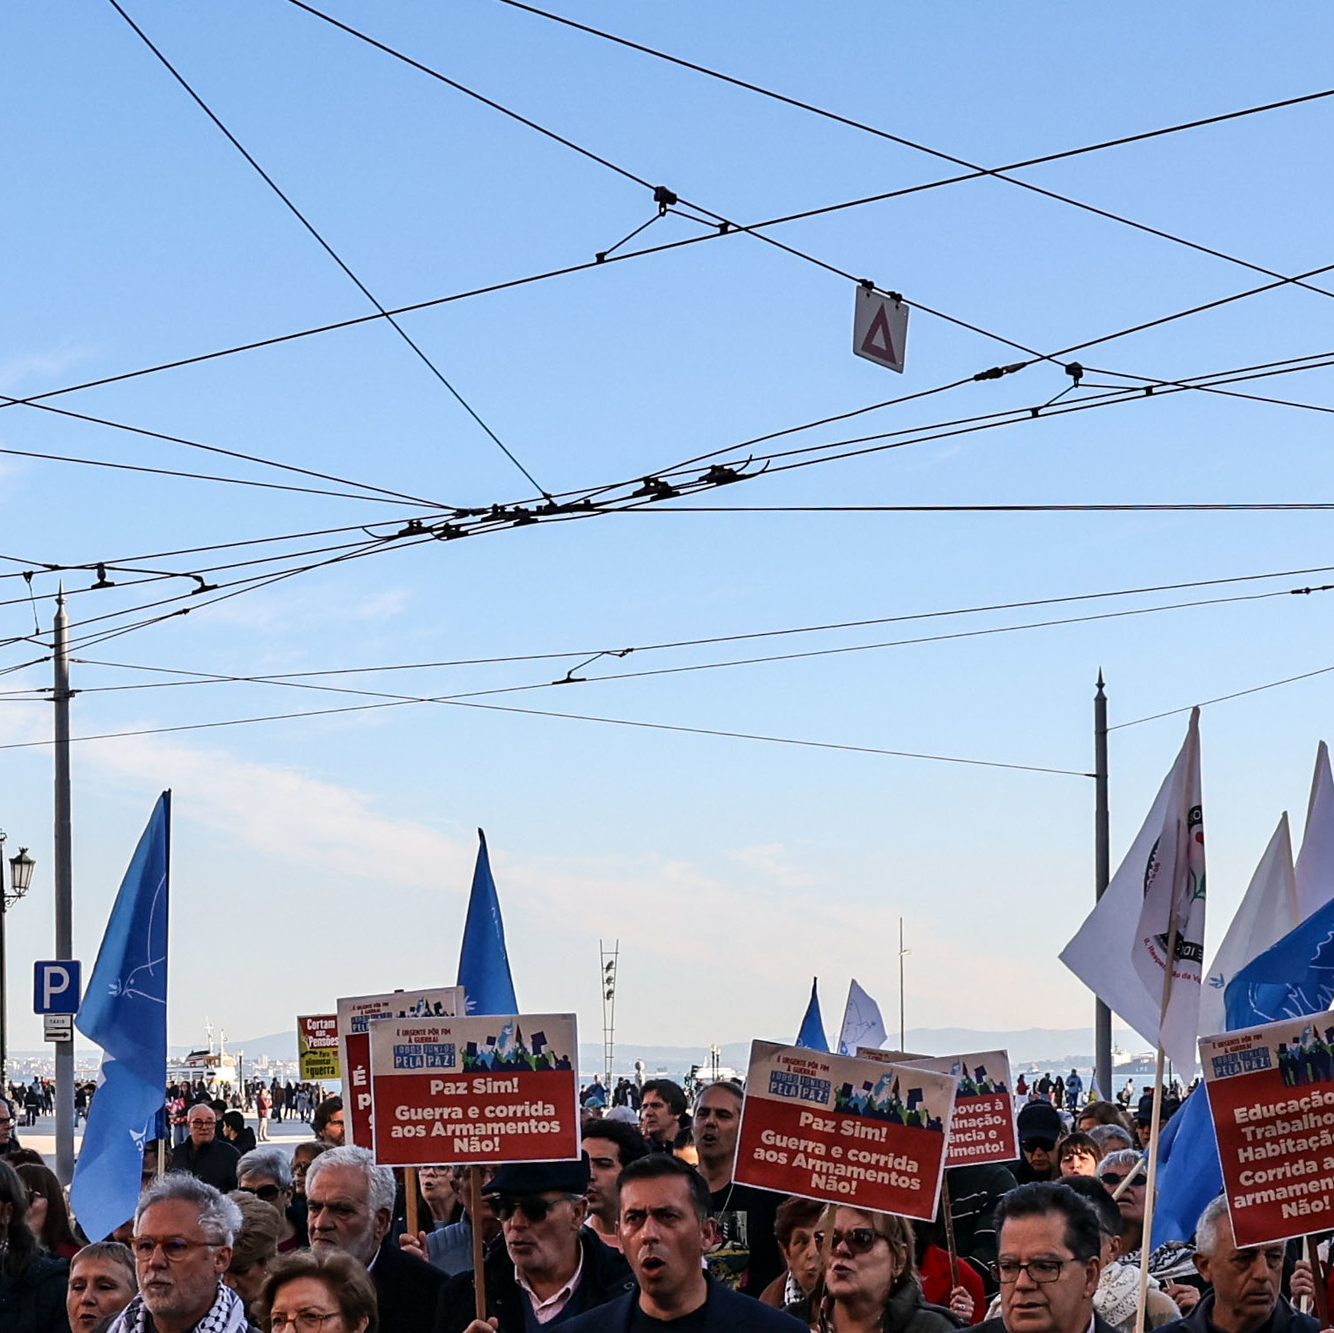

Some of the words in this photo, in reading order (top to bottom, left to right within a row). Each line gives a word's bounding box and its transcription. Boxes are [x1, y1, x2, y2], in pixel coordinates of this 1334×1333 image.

[43, 966, 69, 1009] P
[307, 1018, 335, 1030] Cortam
[308, 1035, 339, 1047] Pensões
[396, 1056, 422, 1067] PELA
[428, 1055, 455, 1066] PAZ!
[310, 1066, 335, 1078] guerra
[353, 1065, 366, 1086] É
[430, 1079, 467, 1095] Paz
[472, 1077, 519, 1093] Sim!
[770, 1082, 796, 1096] PELA
[802, 1088, 828, 1101] PAZ!
[395, 1105, 463, 1121] Guerra
[468, 1107, 480, 1119] e
[485, 1101, 555, 1118] corrida
[995, 1099, 1004, 1111] à
[391, 1125, 426, 1138] aos
[431, 1119, 560, 1136] Armamentos
[799, 1112, 836, 1134] Paz
[840, 1119, 887, 1143] Sim!
[989, 1130, 997, 1139] e
[454, 1137, 500, 1153] Não!
[761, 1129, 826, 1156] Guerra
[831, 1143, 842, 1155] e
[848, 1149, 918, 1173] corrida
[753, 1147, 787, 1165] aos
[792, 1153, 920, 1191] Armamentos
[1239, 1159, 1318, 1187] Corrida
[811, 1174, 857, 1195] Não!
[1281, 1196, 1331, 1219] Não!
